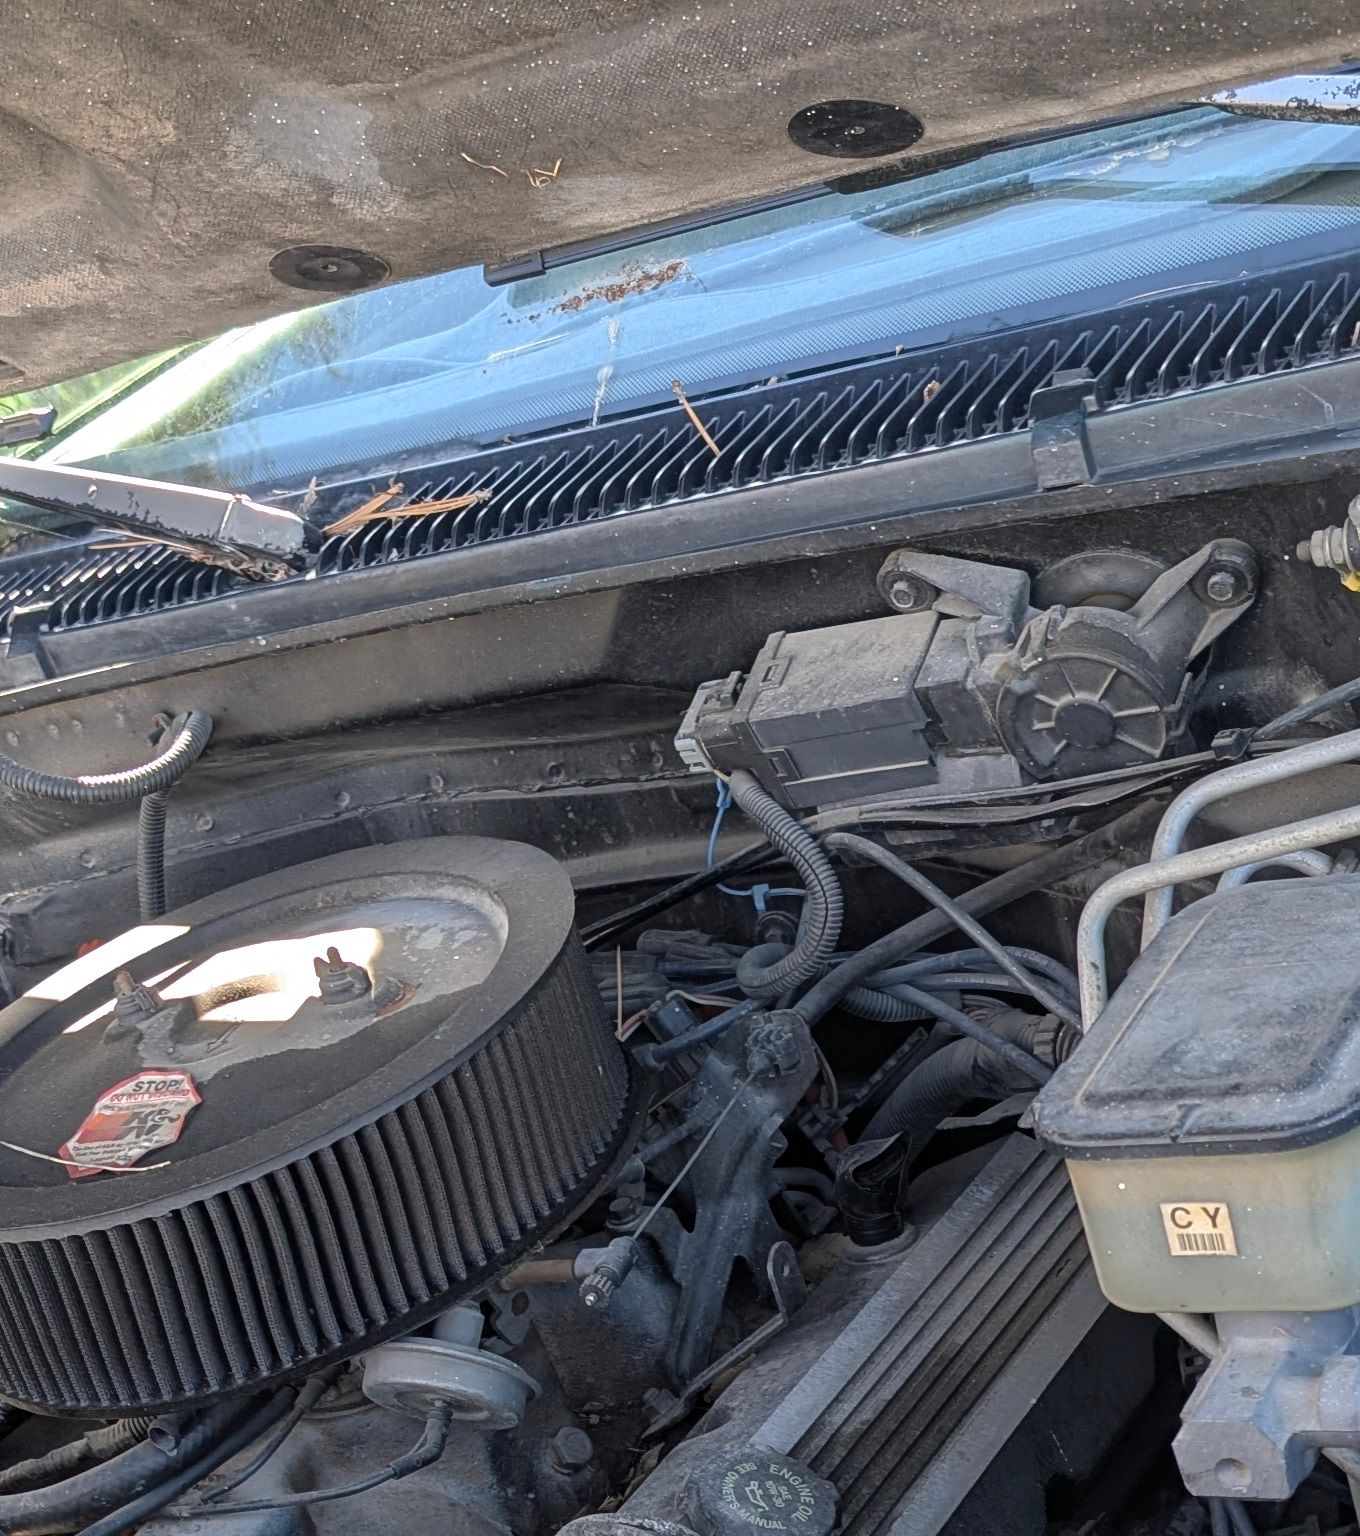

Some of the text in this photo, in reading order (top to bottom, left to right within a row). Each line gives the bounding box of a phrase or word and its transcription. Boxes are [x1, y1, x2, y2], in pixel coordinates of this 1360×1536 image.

[132, 1079, 183, 1093] STOP!
[734, 1462, 758, 1475] SEE
[769, 1463, 815, 1522] ENGINE OIL
[778, 1485, 793, 1501] SAE
[739, 1509, 787, 1530] MANUAL
